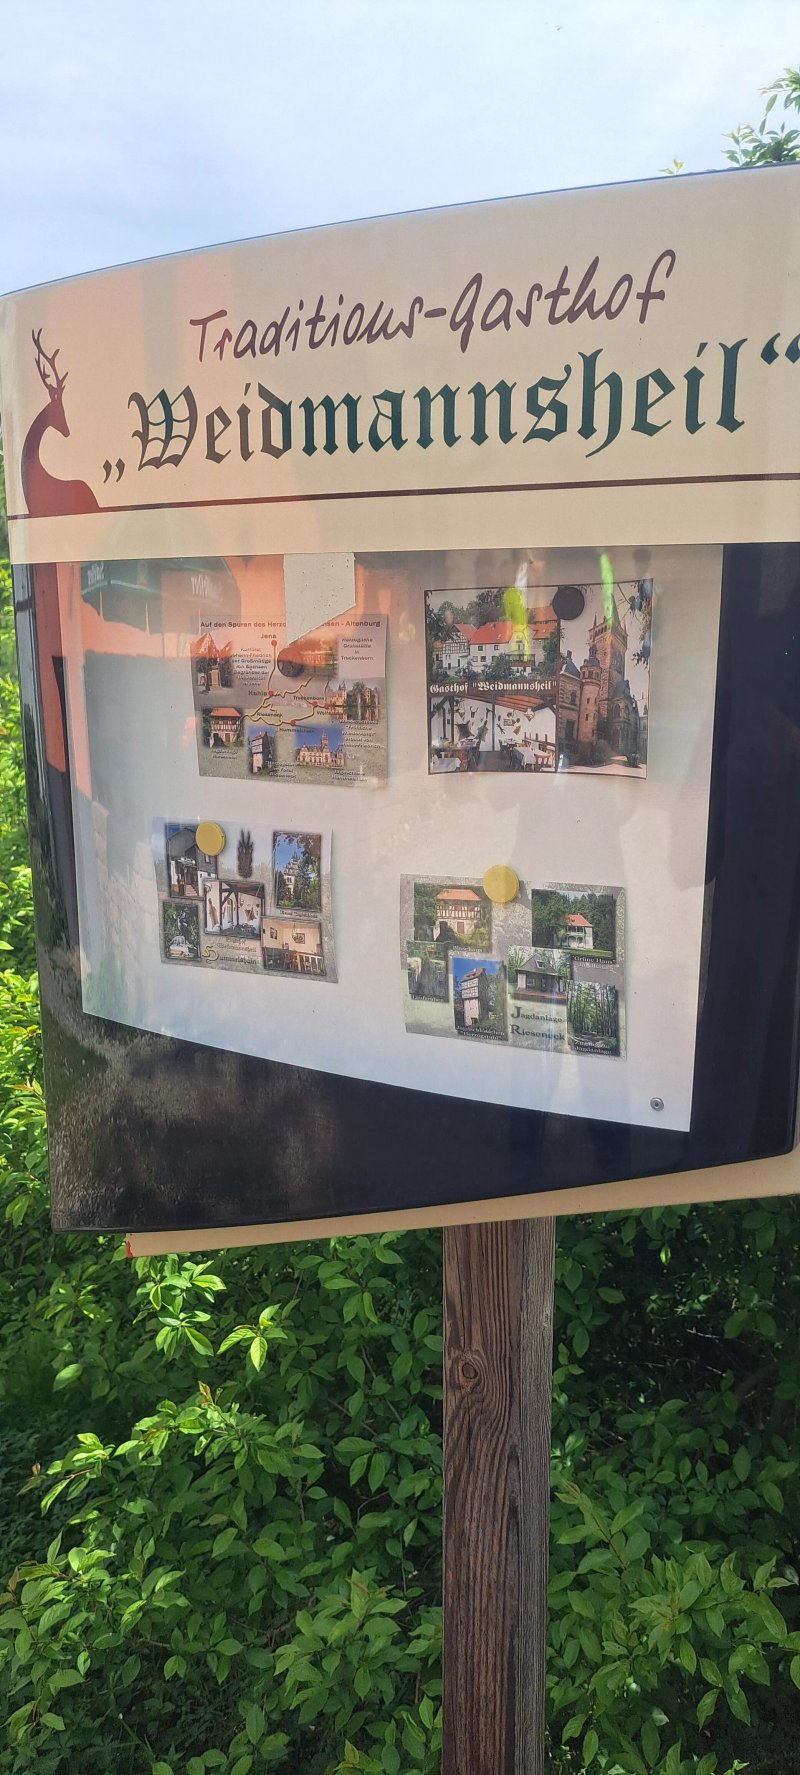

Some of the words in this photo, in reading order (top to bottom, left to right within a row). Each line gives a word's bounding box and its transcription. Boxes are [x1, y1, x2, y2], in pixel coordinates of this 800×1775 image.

[190, 249, 676, 363] Traditions-Gasthof
[344, 620, 381, 628] Altenburg
[430, 682, 469, 694] Gasthof
[473, 680, 557, 691] "Weidmannsheil"
[509, 1024, 566, 1041] Rieseneck
